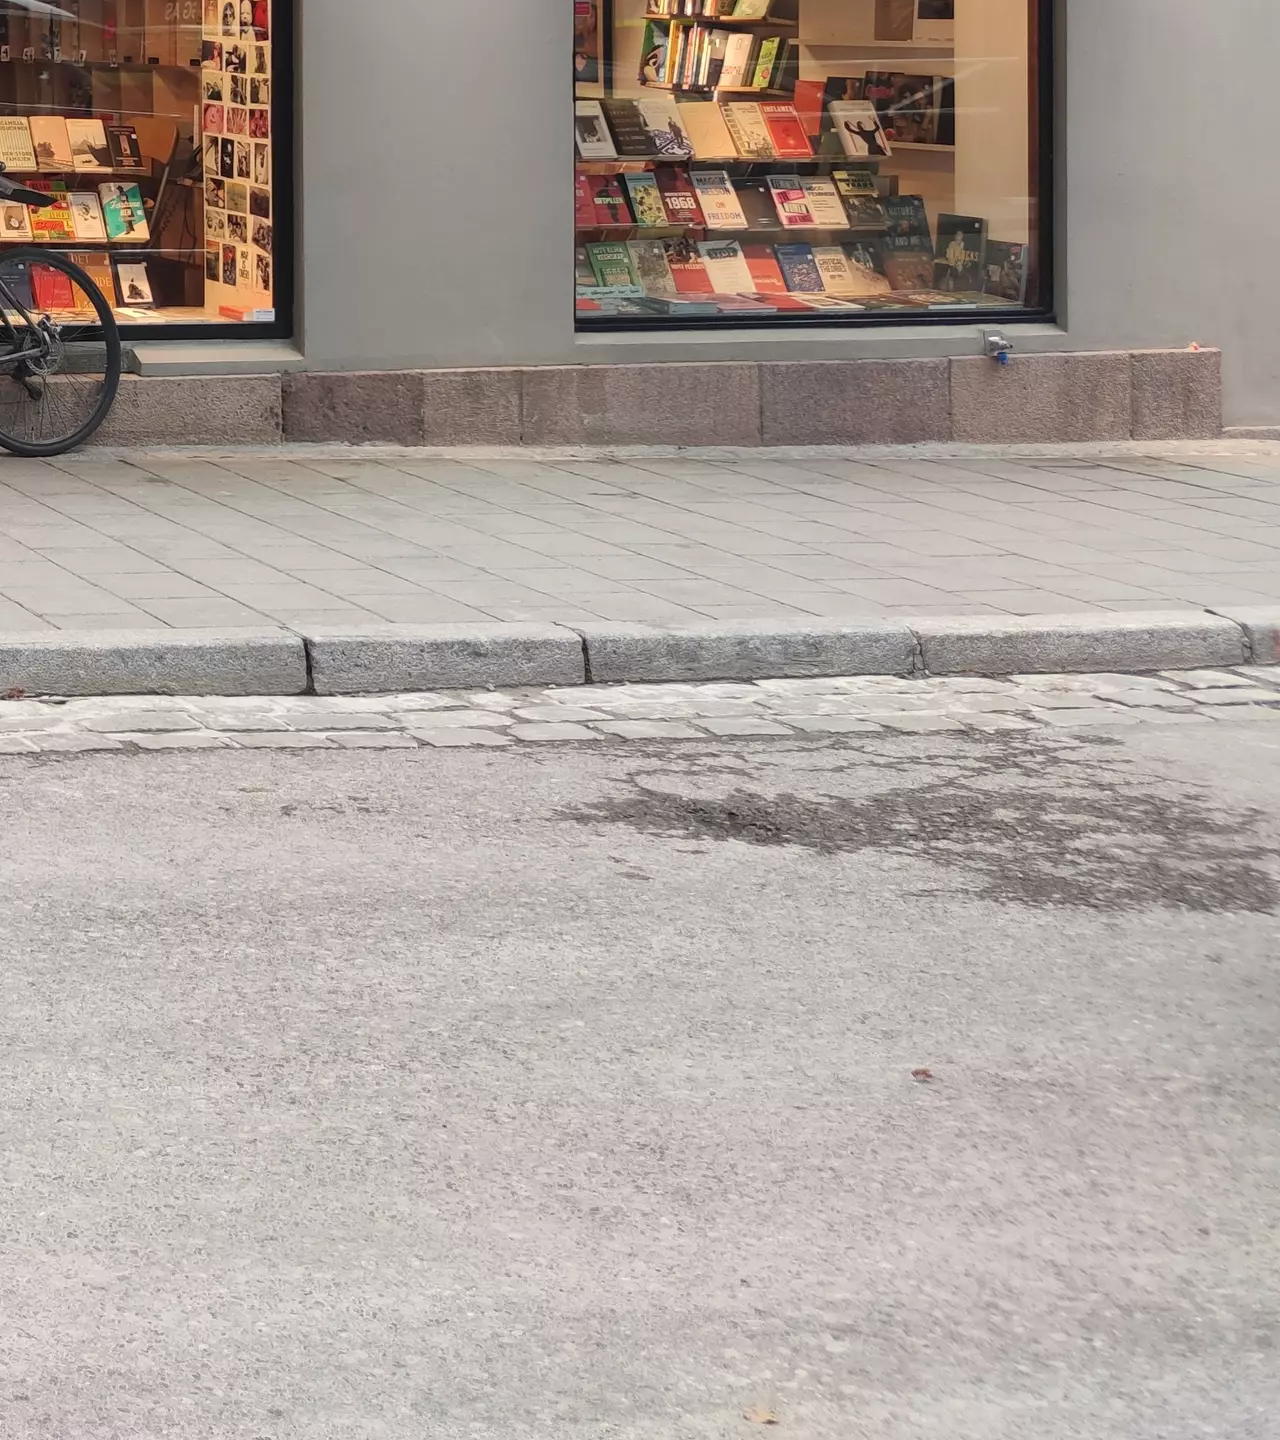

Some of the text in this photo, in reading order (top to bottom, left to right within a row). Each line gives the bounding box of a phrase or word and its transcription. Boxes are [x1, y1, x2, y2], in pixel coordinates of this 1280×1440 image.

[696, 176, 727, 185] MAGGIE
[715, 201, 725, 209] ON
[707, 212, 743, 220] FREEDOM
[71, 253, 89, 264] DET
